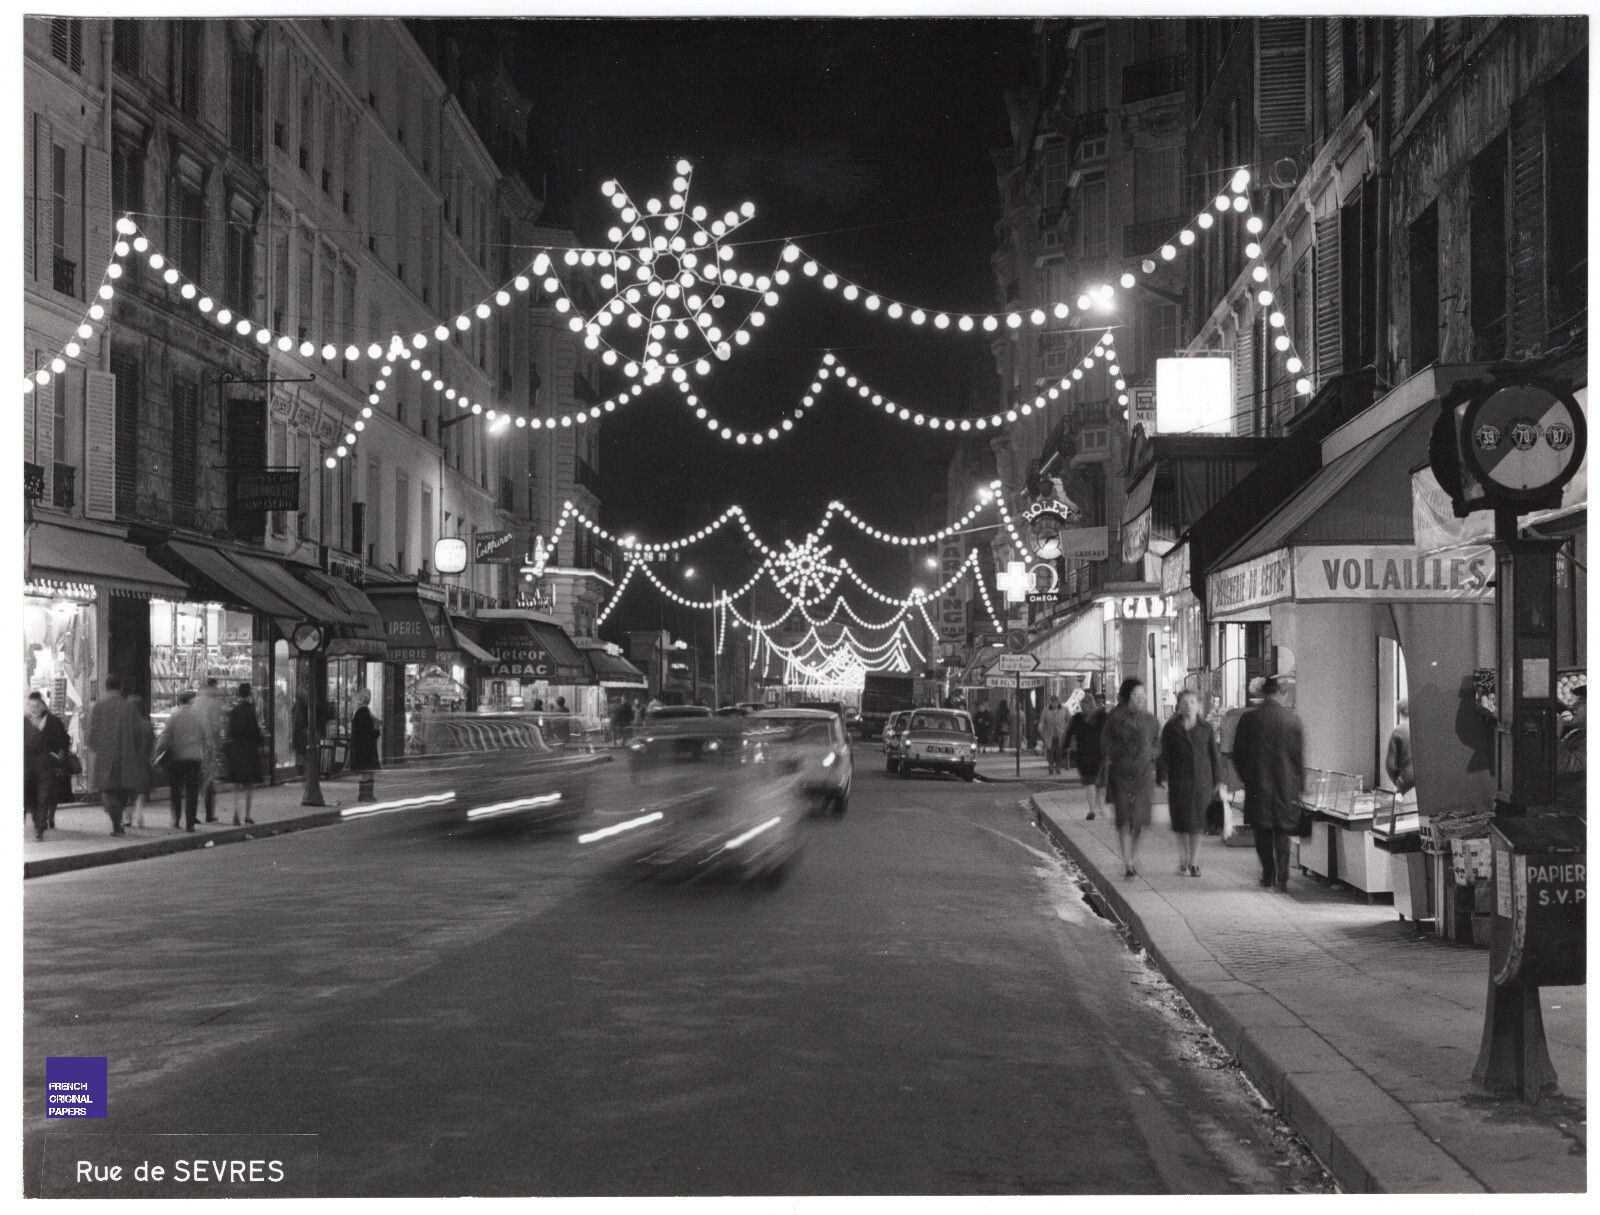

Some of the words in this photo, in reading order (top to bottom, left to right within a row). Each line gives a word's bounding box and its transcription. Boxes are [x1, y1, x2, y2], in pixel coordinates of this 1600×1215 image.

[1481, 430, 1495, 444] 39
[1518, 429, 1530, 443] 70
[1552, 429, 1564, 443] 87
[1022, 500, 1069, 522] ROLEX
[1075, 550, 1105, 558] CADEAUX
[1322, 557, 1487, 591] VOLAILLES
[489, 664, 548, 675] TABAC
[1527, 864, 1586, 883] PAPIER
